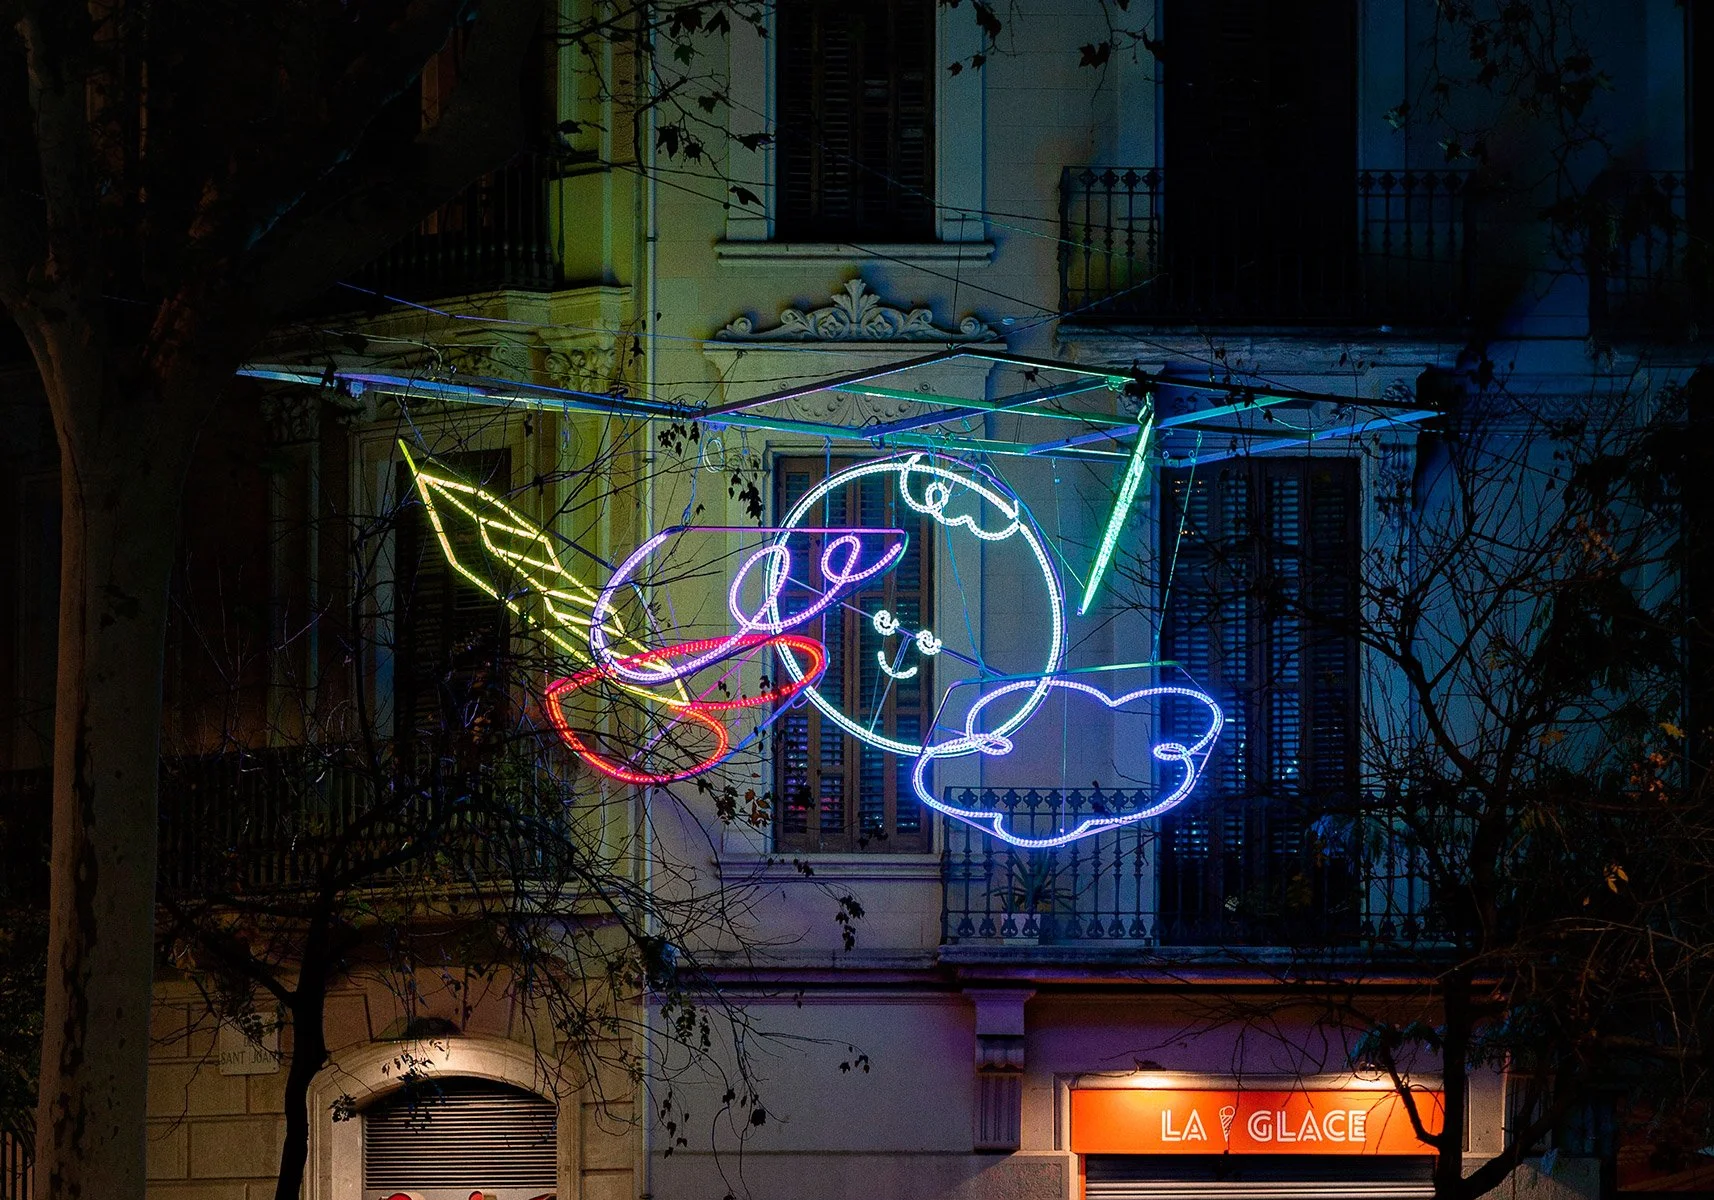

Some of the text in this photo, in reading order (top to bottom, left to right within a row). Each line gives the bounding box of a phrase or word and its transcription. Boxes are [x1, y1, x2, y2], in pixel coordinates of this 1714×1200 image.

[221, 1051, 246, 1065] SANT
[1161, 1109, 1366, 1142] LA GLACE
